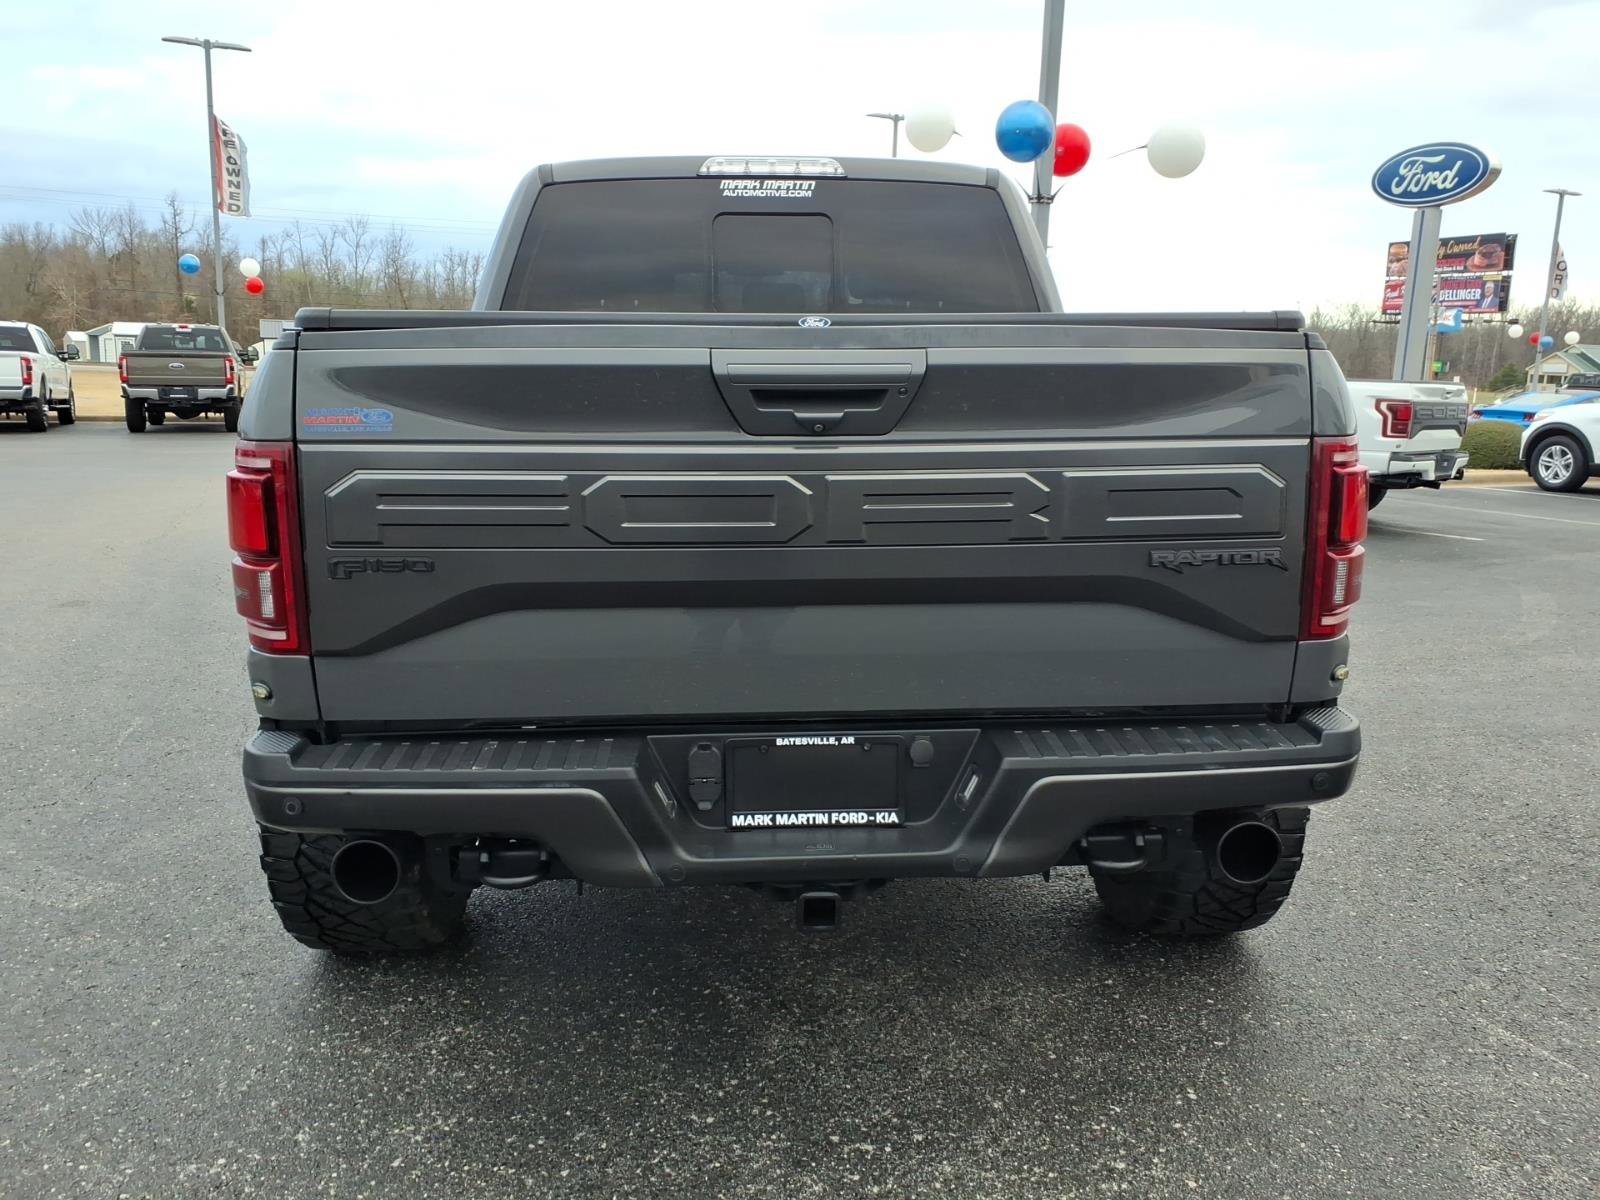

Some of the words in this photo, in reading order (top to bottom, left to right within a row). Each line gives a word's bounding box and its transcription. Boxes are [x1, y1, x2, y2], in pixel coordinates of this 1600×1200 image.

[1391, 154, 1463, 195] Ford
[226, 155, 242, 213] OWNED
[720, 180, 761, 189] MARK
[762, 180, 816, 190] MARTIN
[722, 189, 813, 198] AUTOMOTIVE.COM
[1439, 288, 1482, 301] DELLINGER
[326, 468, 1286, 546] FORD
[1149, 549, 1289, 574] RAPTOR
[775, 736, 839, 747] BATESVILLE,
[840, 736, 855, 745] AR
[731, 814, 773, 827] MARK
[775, 812, 829, 826] MARTIN
